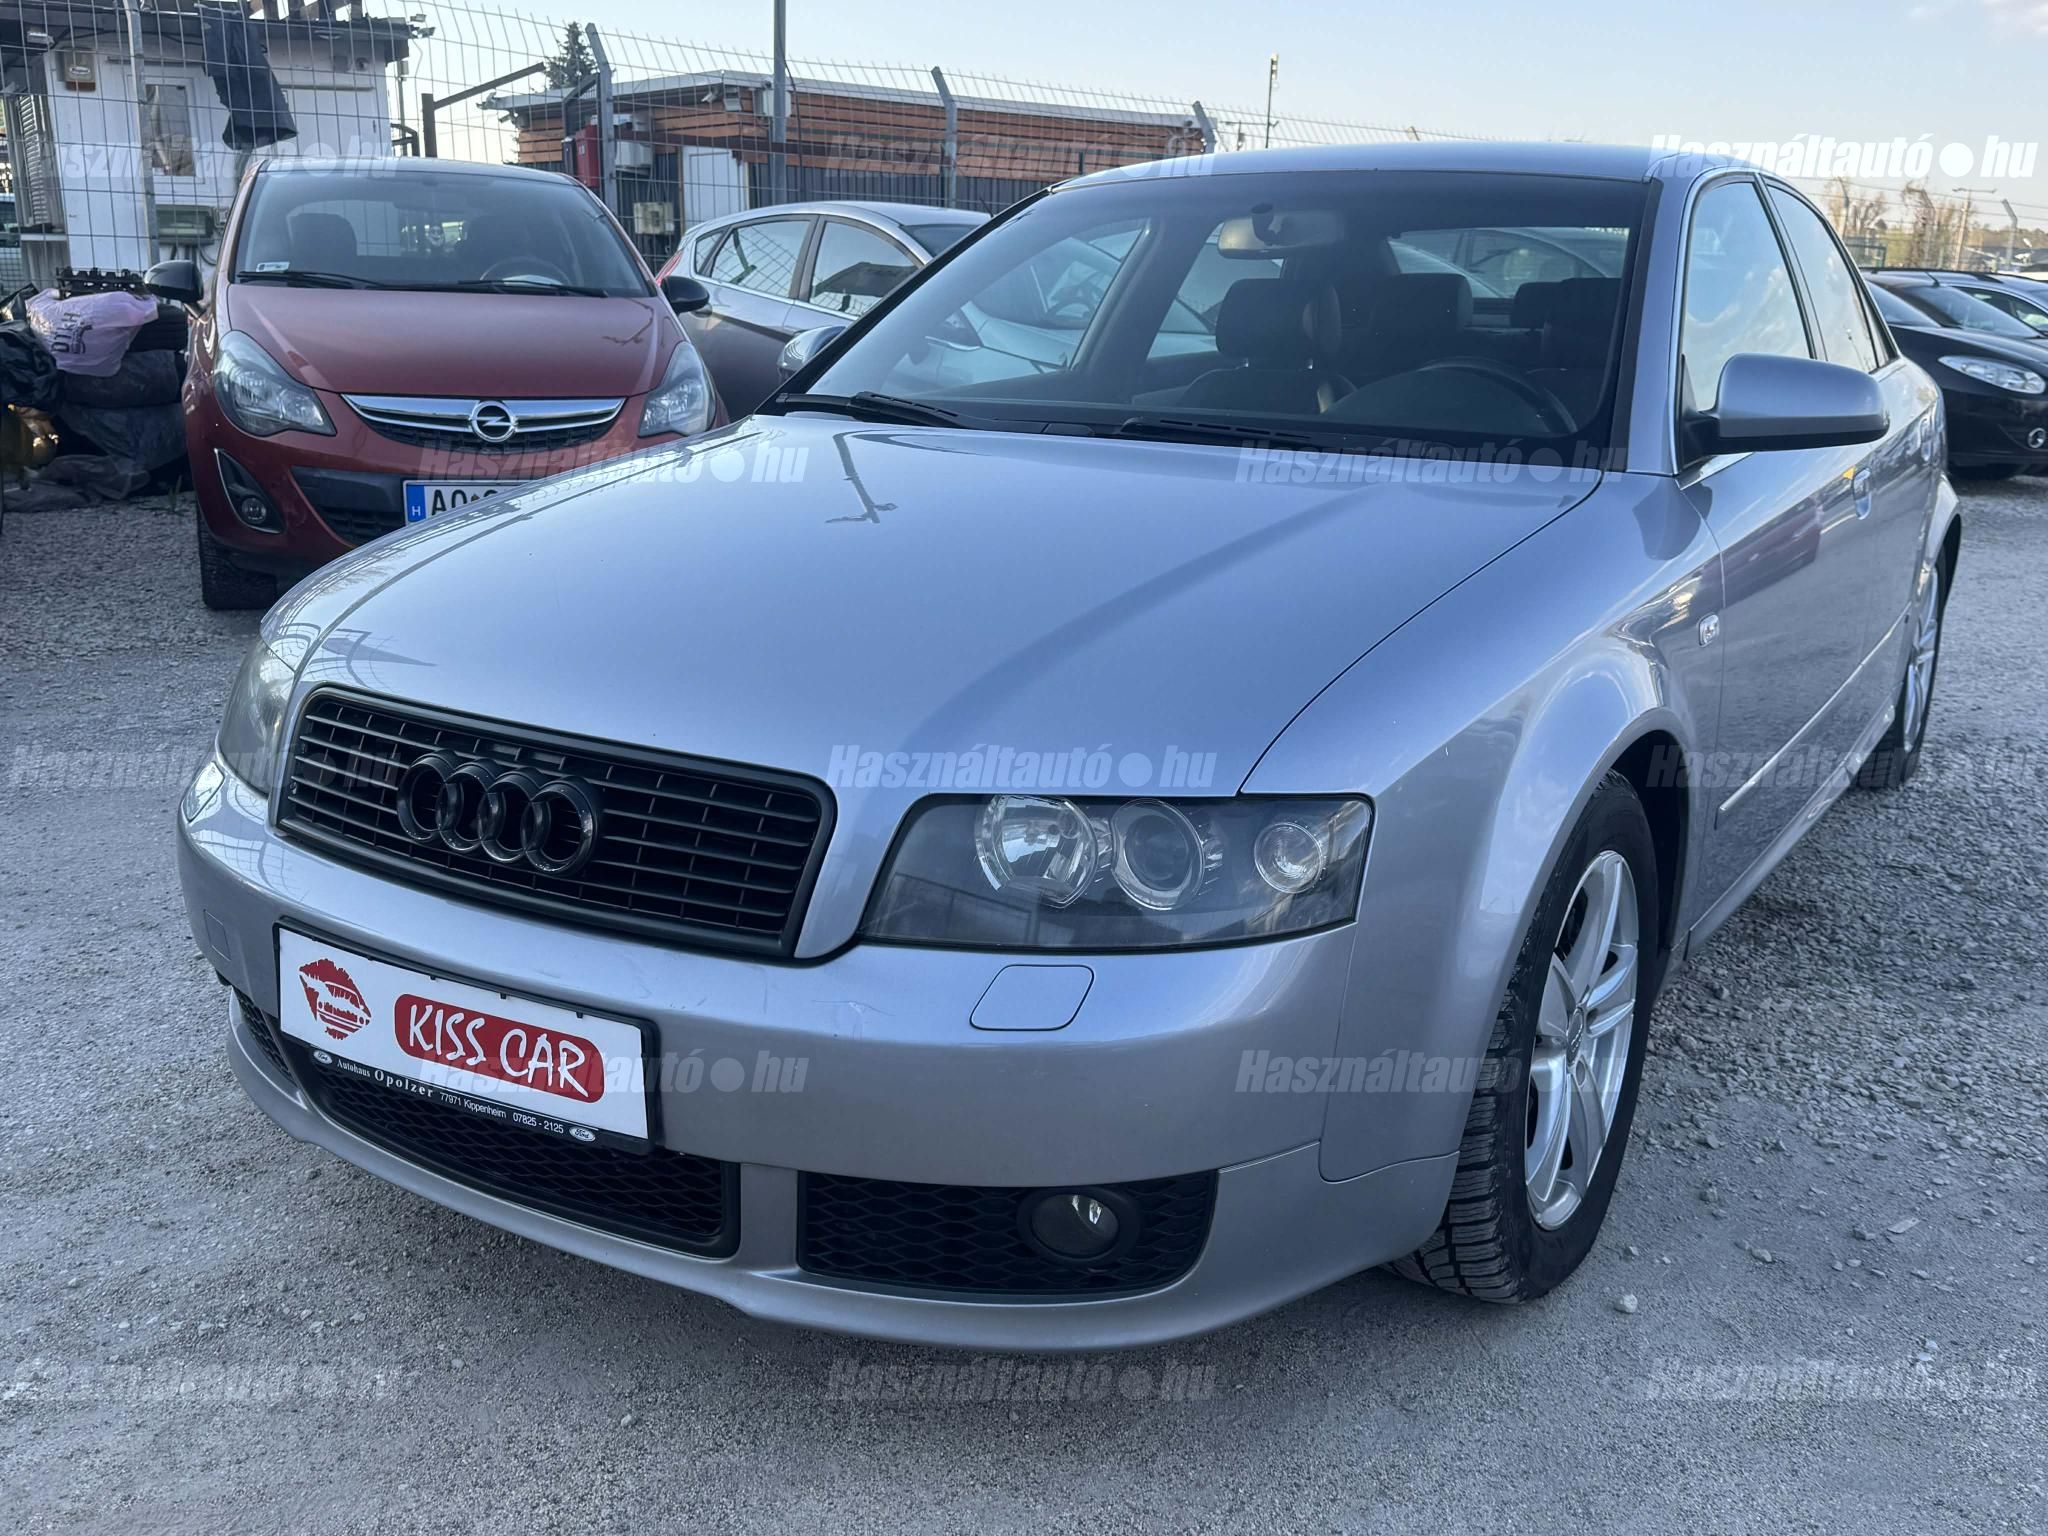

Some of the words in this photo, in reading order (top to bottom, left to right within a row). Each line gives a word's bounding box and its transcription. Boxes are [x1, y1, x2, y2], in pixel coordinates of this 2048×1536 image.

[408, 1003, 487, 1066] KISS
[499, 1028, 590, 1098] CAR
[337, 1059, 371, 1078] Autohaus
[374, 1069, 434, 1098] Opolzer
[440, 1091, 461, 1106] 77971
[463, 1098, 507, 1119] Kippenheim
